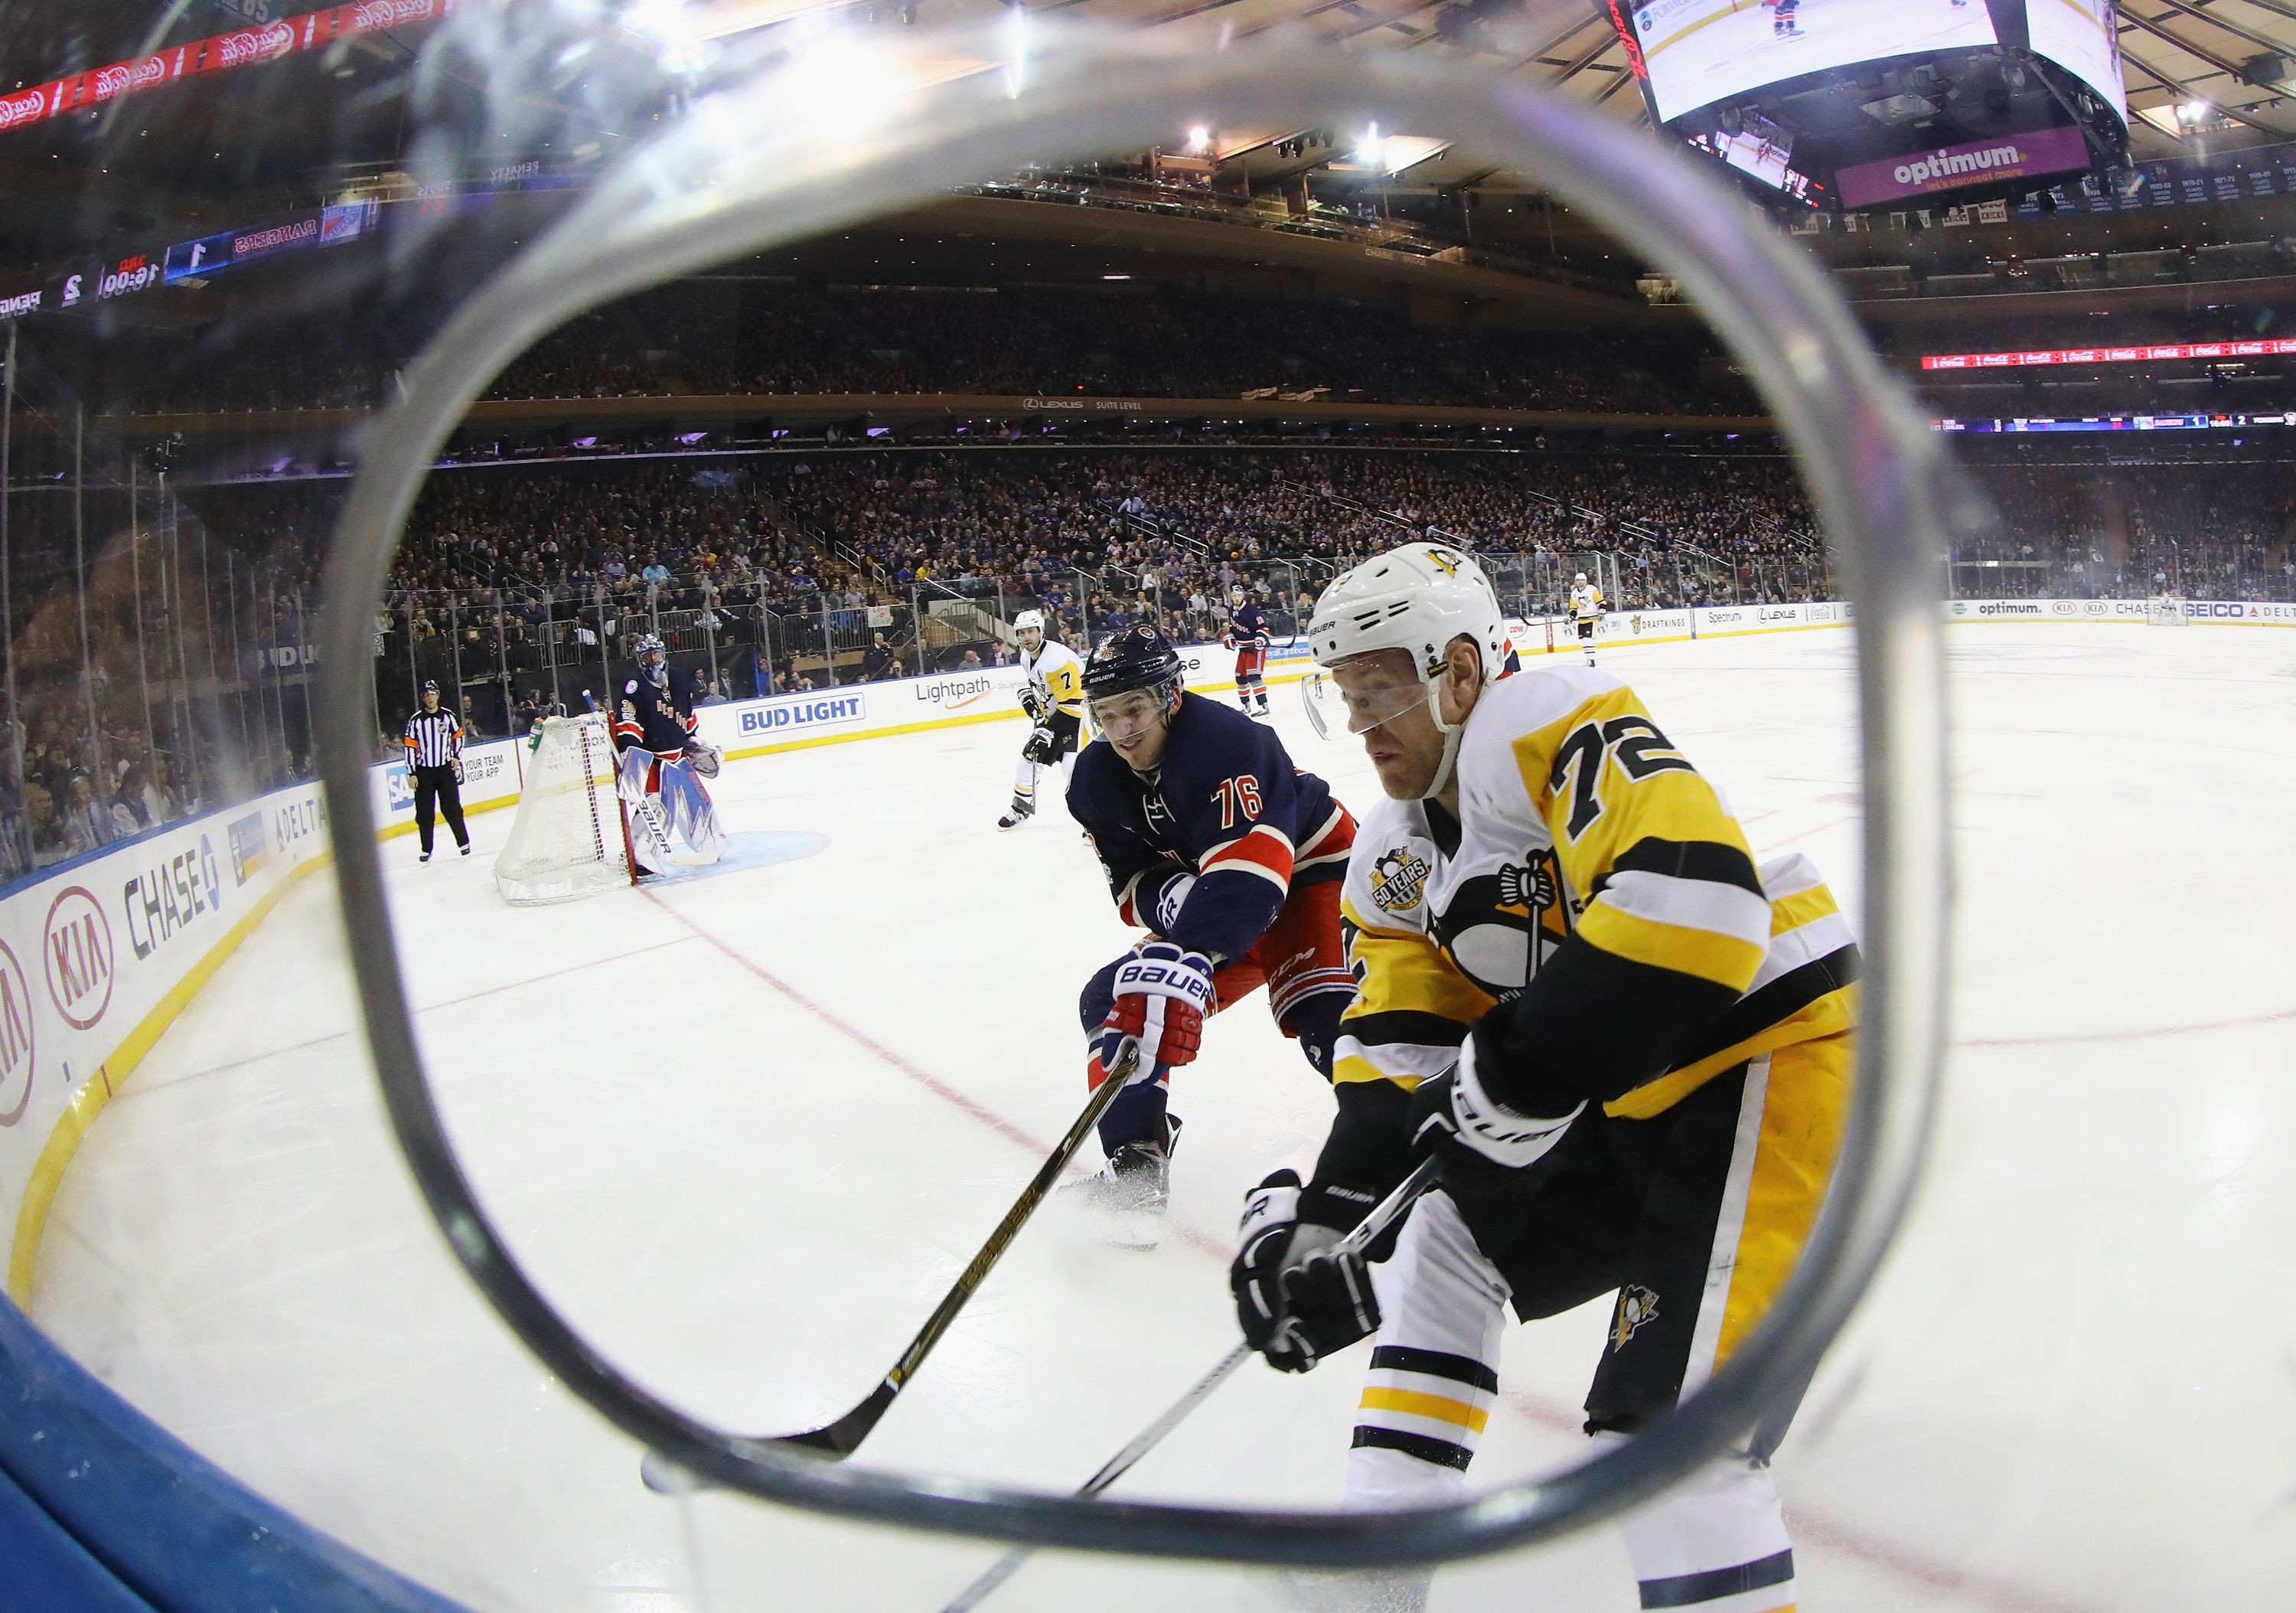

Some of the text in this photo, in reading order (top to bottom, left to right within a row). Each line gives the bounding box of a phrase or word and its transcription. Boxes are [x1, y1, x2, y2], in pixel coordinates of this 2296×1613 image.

[1039, 400, 1084, 409] LEXUS
[1120, 402, 1142, 410] LEVEL
[1768, 609, 1796, 619] LEXUS
[2116, 603, 2161, 614] CHASE
[2182, 603, 2244, 618] GEICO
[2264, 607, 2296, 617] DELT
[1642, 619, 1685, 630] DRAFTKINGS
[1709, 612, 1741, 625] Spectrum
[1060, 671, 1071, 691] 7
[1089, 673, 1116, 684] BAUER
[916, 677, 990, 703] Lightpath
[656, 700, 674, 719] NEW
[742, 698, 859, 731] BUD LIGHT
[1036, 729, 1055, 740] BAU
[465, 755, 504, 770] YOUR TEAM
[466, 767, 500, 782] YOUR APP
[1549, 714, 1699, 847] 72
[388, 773, 415, 804] SA
[1211, 774, 1263, 830] 76
[282, 797, 328, 843] DELTA
[1374, 886, 1391, 906] 50
[1388, 860, 1426, 894] YEARS
[125, 848, 206, 962] CHASE
[51, 913, 108, 1008] KIA
